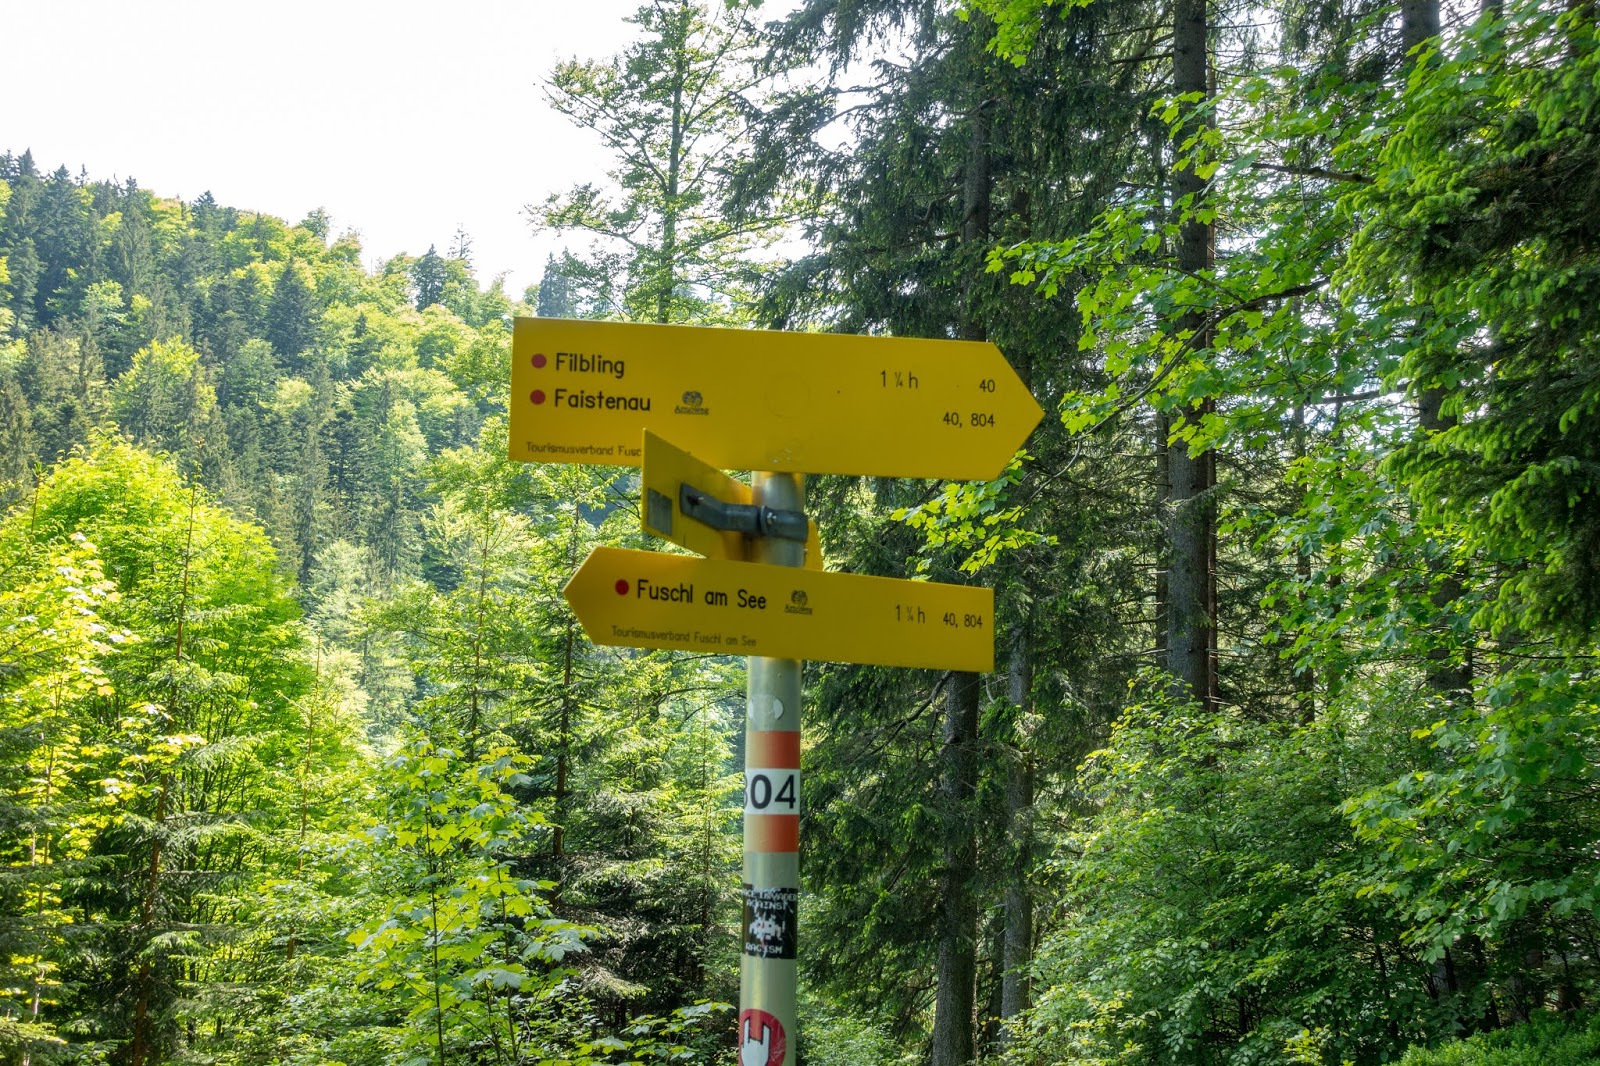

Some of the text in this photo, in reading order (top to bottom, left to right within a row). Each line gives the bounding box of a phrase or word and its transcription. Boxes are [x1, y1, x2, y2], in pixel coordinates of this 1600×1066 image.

[555, 352, 625, 379] Filbling
[880, 370, 887, 387] 1
[908, 371, 918, 389] h
[979, 378, 995, 393] 40
[554, 388, 651, 411] Faistenau
[943, 411, 996, 428] 40, 804
[526, 441, 642, 456] Tourismusverband Fusc
[637, 579, 767, 610] Fuschl am See
[896, 604, 902, 621] 1
[917, 605, 927, 624] h
[943, 612, 983, 629] 40, 804
[612, 625, 757, 648] Tourismusverband Fuschl am See
[743, 773, 797, 810] 04
[745, 943, 783, 955] RACISM
